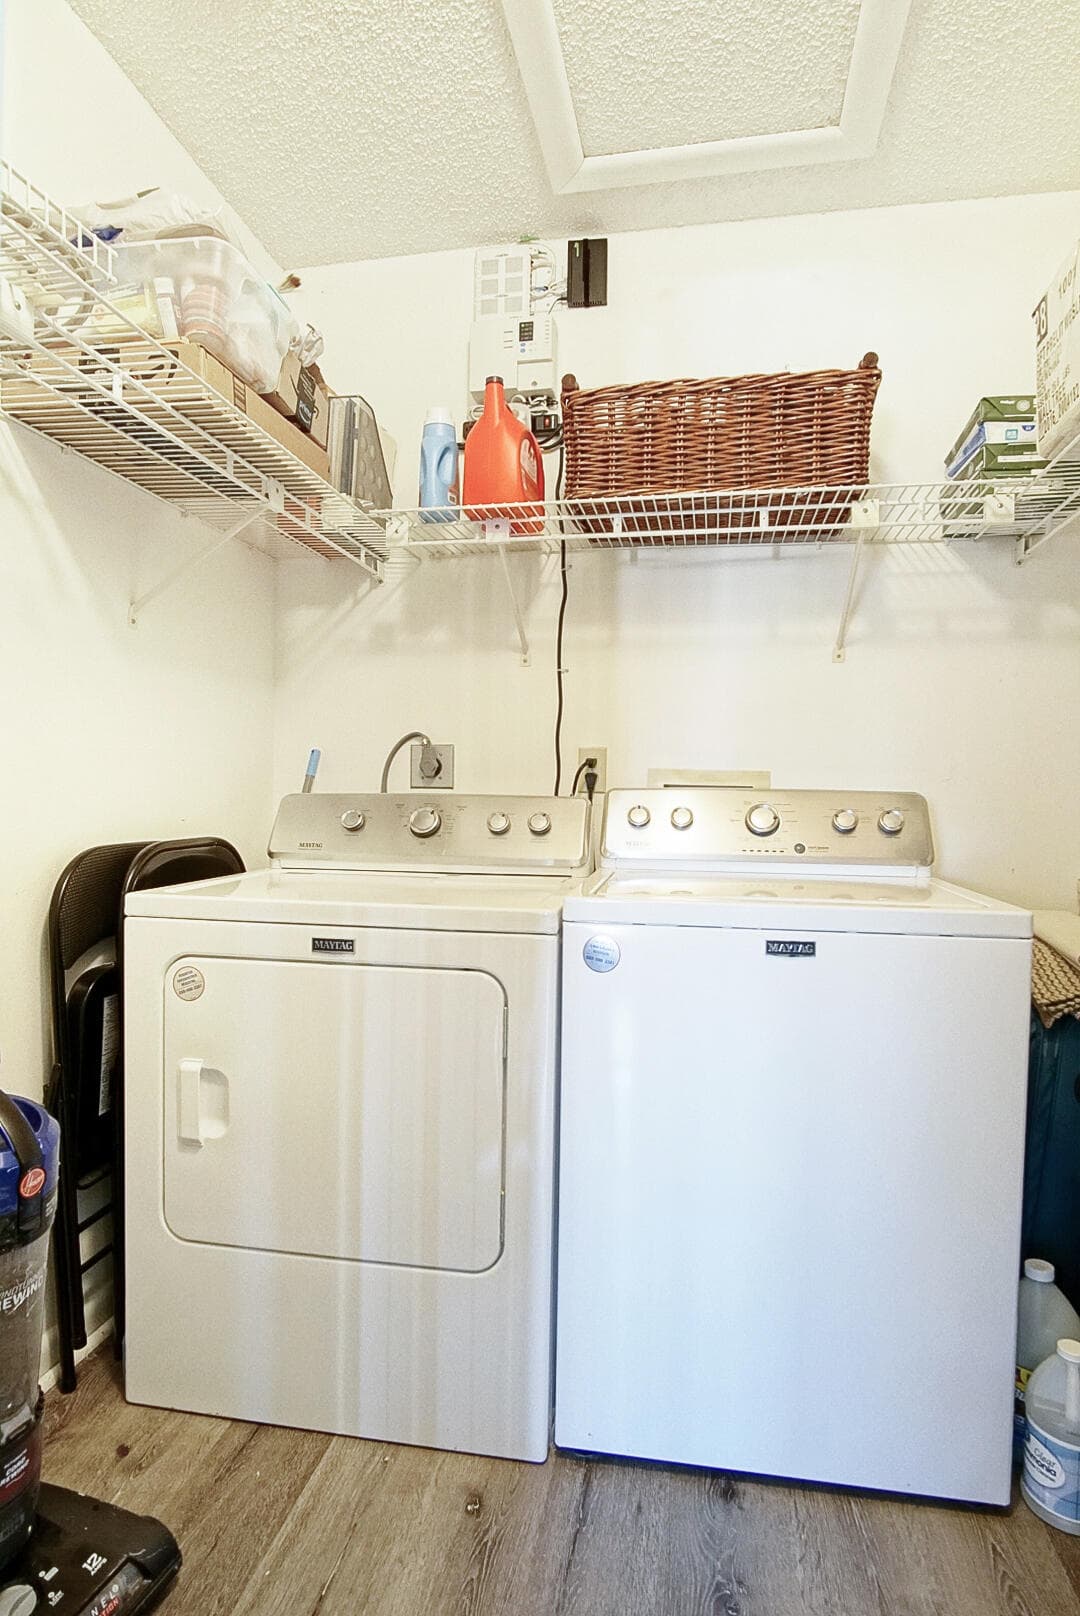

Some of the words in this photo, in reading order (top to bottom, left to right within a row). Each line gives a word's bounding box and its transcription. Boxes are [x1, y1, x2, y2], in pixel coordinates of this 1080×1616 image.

[314, 940, 353, 950] MAYTAG
[767, 942, 814, 953] MAYTAG
[0, 1275, 43, 1311] EWIND
[82, 1552, 102, 1572] 12
